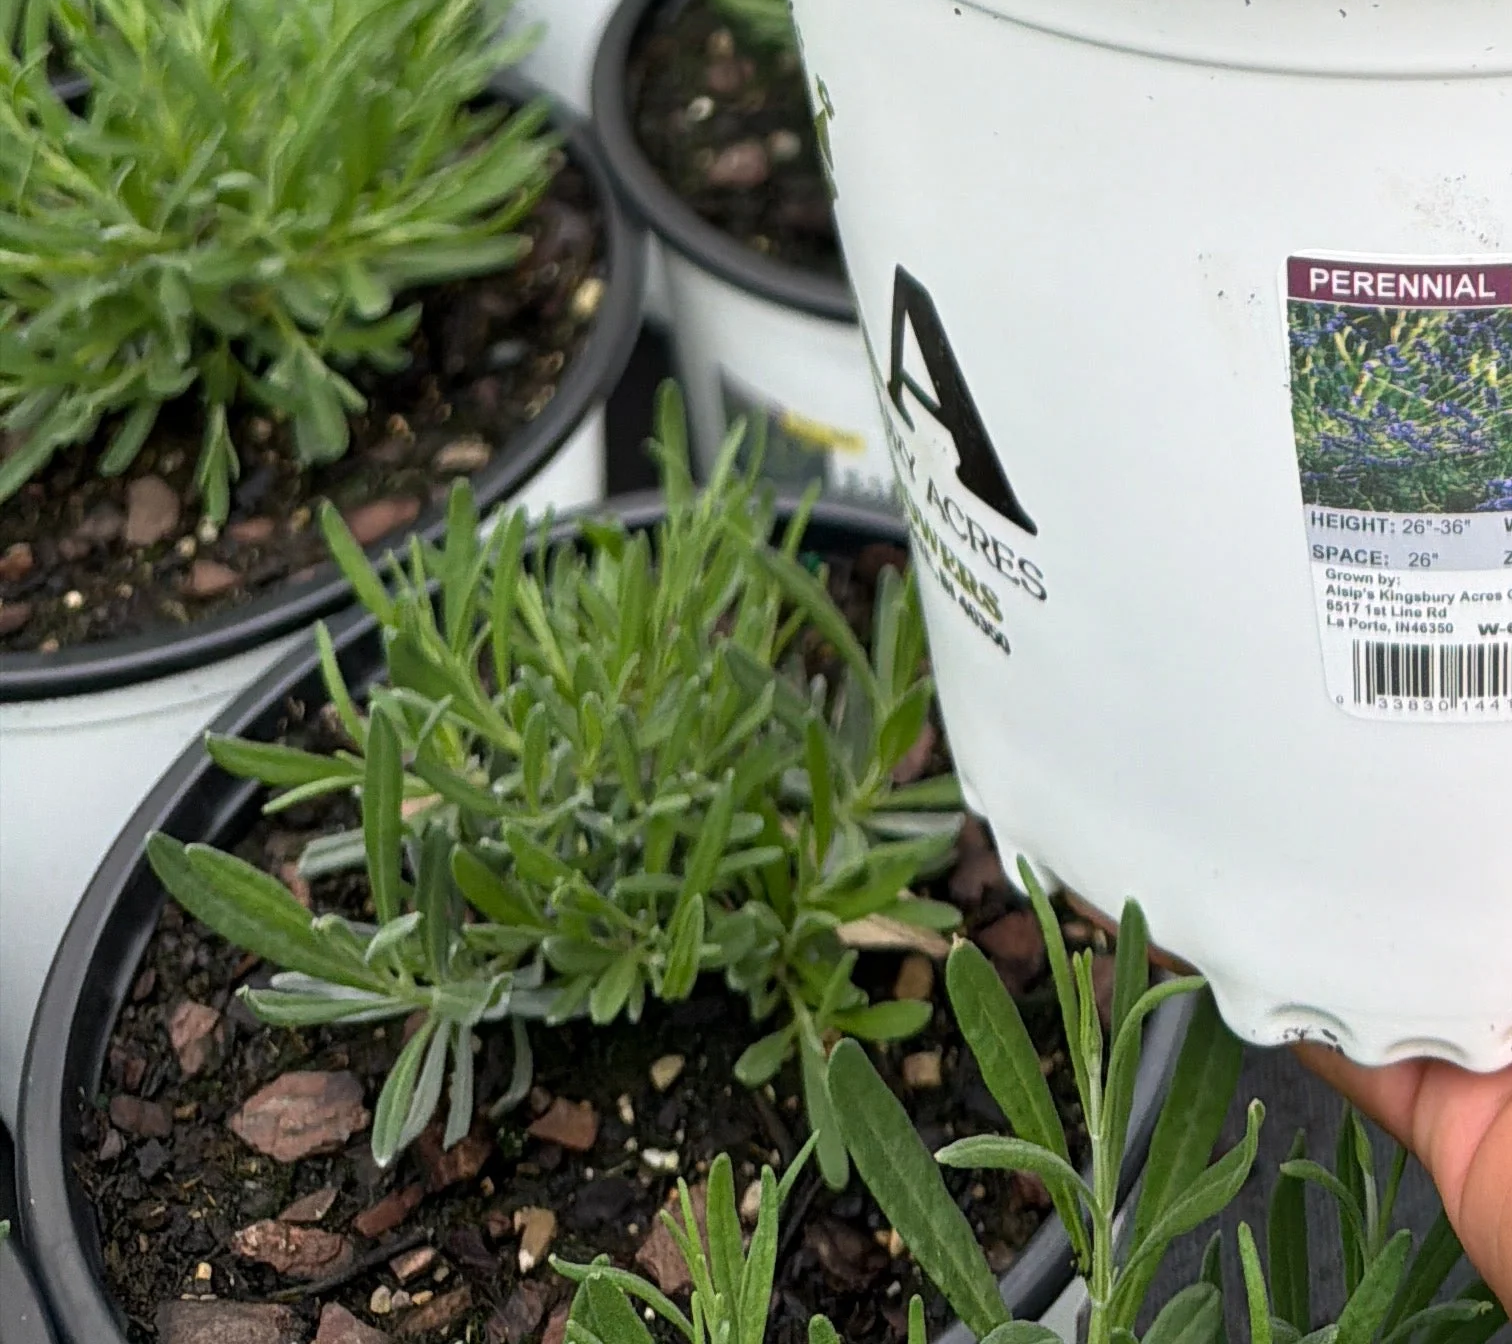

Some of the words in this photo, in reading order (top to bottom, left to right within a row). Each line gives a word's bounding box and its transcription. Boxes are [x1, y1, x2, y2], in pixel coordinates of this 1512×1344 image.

[1310, 268, 1496, 300] PERENNIAL
[1311, 511, 1395, 534] HEIGHT:
[1402, 518, 1471, 535] 26"-36"
[927, 477, 1047, 601] ACRES
[1312, 544, 1389, 565] SPACE:
[1408, 552, 1438, 568] 26"
[1326, 568, 1373, 585] Grown
[1378, 573, 1401, 587] by:
[1326, 584, 1375, 600] Alsip's
[1379, 590, 1455, 606] Kingsbury
[1460, 591, 1502, 603] Acres
[1365, 604, 1387, 617] 1st
[1390, 605, 1422, 618] Line
[1427, 606, 1447, 618] Rd
[1326, 615, 1345, 628] La
[1348, 616, 1392, 634] Porte,
